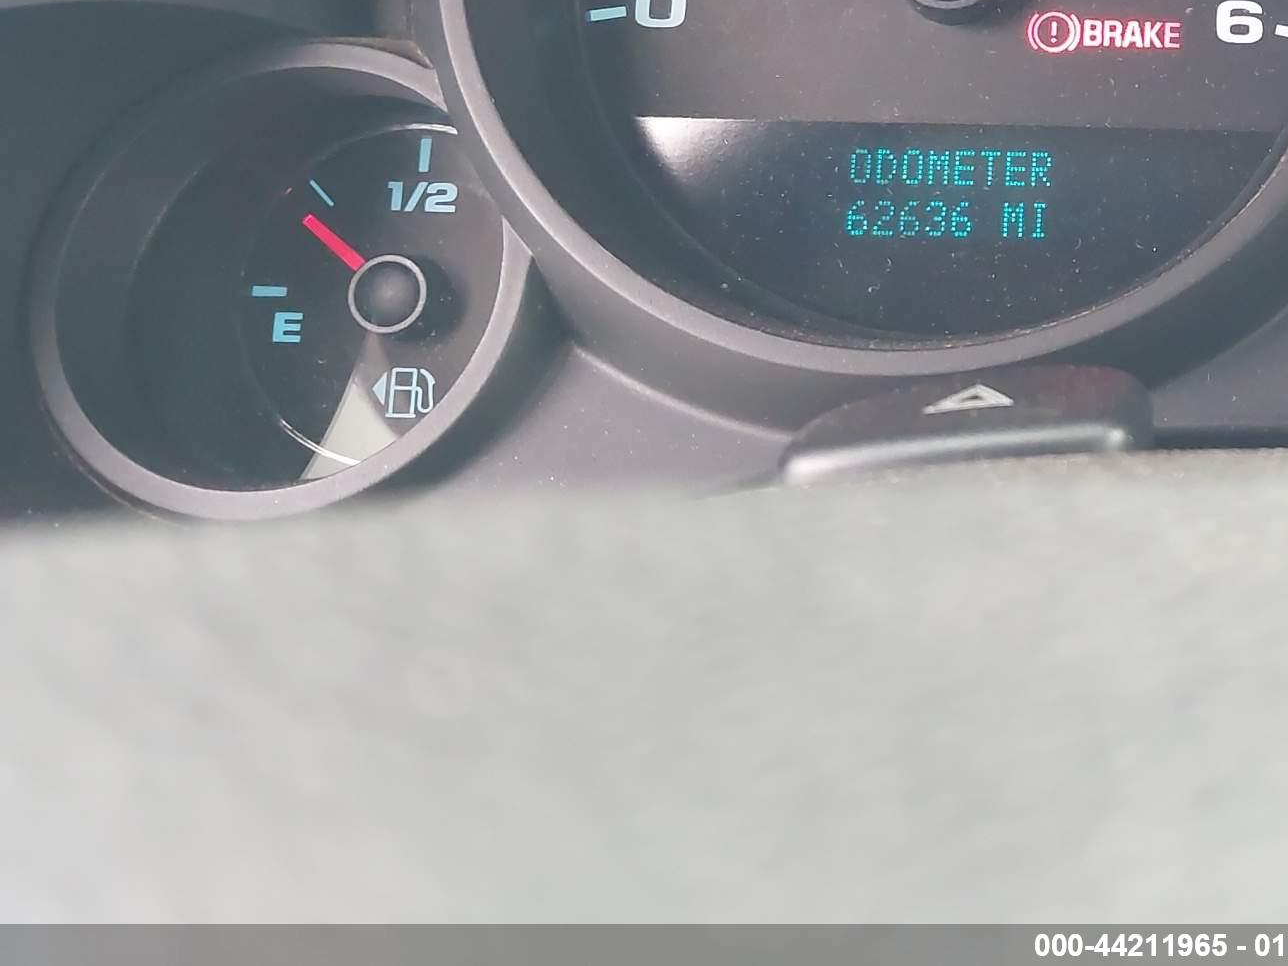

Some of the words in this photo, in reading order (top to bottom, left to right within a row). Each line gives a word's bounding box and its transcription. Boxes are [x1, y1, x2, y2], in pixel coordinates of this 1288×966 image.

[1083, 18, 1181, 49] BRAKE
[1216, 0, 1264, 44] 6
[850, 148, 1052, 187] ODOMETER
[386, 181, 458, 213] 1/2
[846, 200, 972, 237] 62636
[1002, 202, 1048, 238] MI
[272, 312, 304, 343] E
